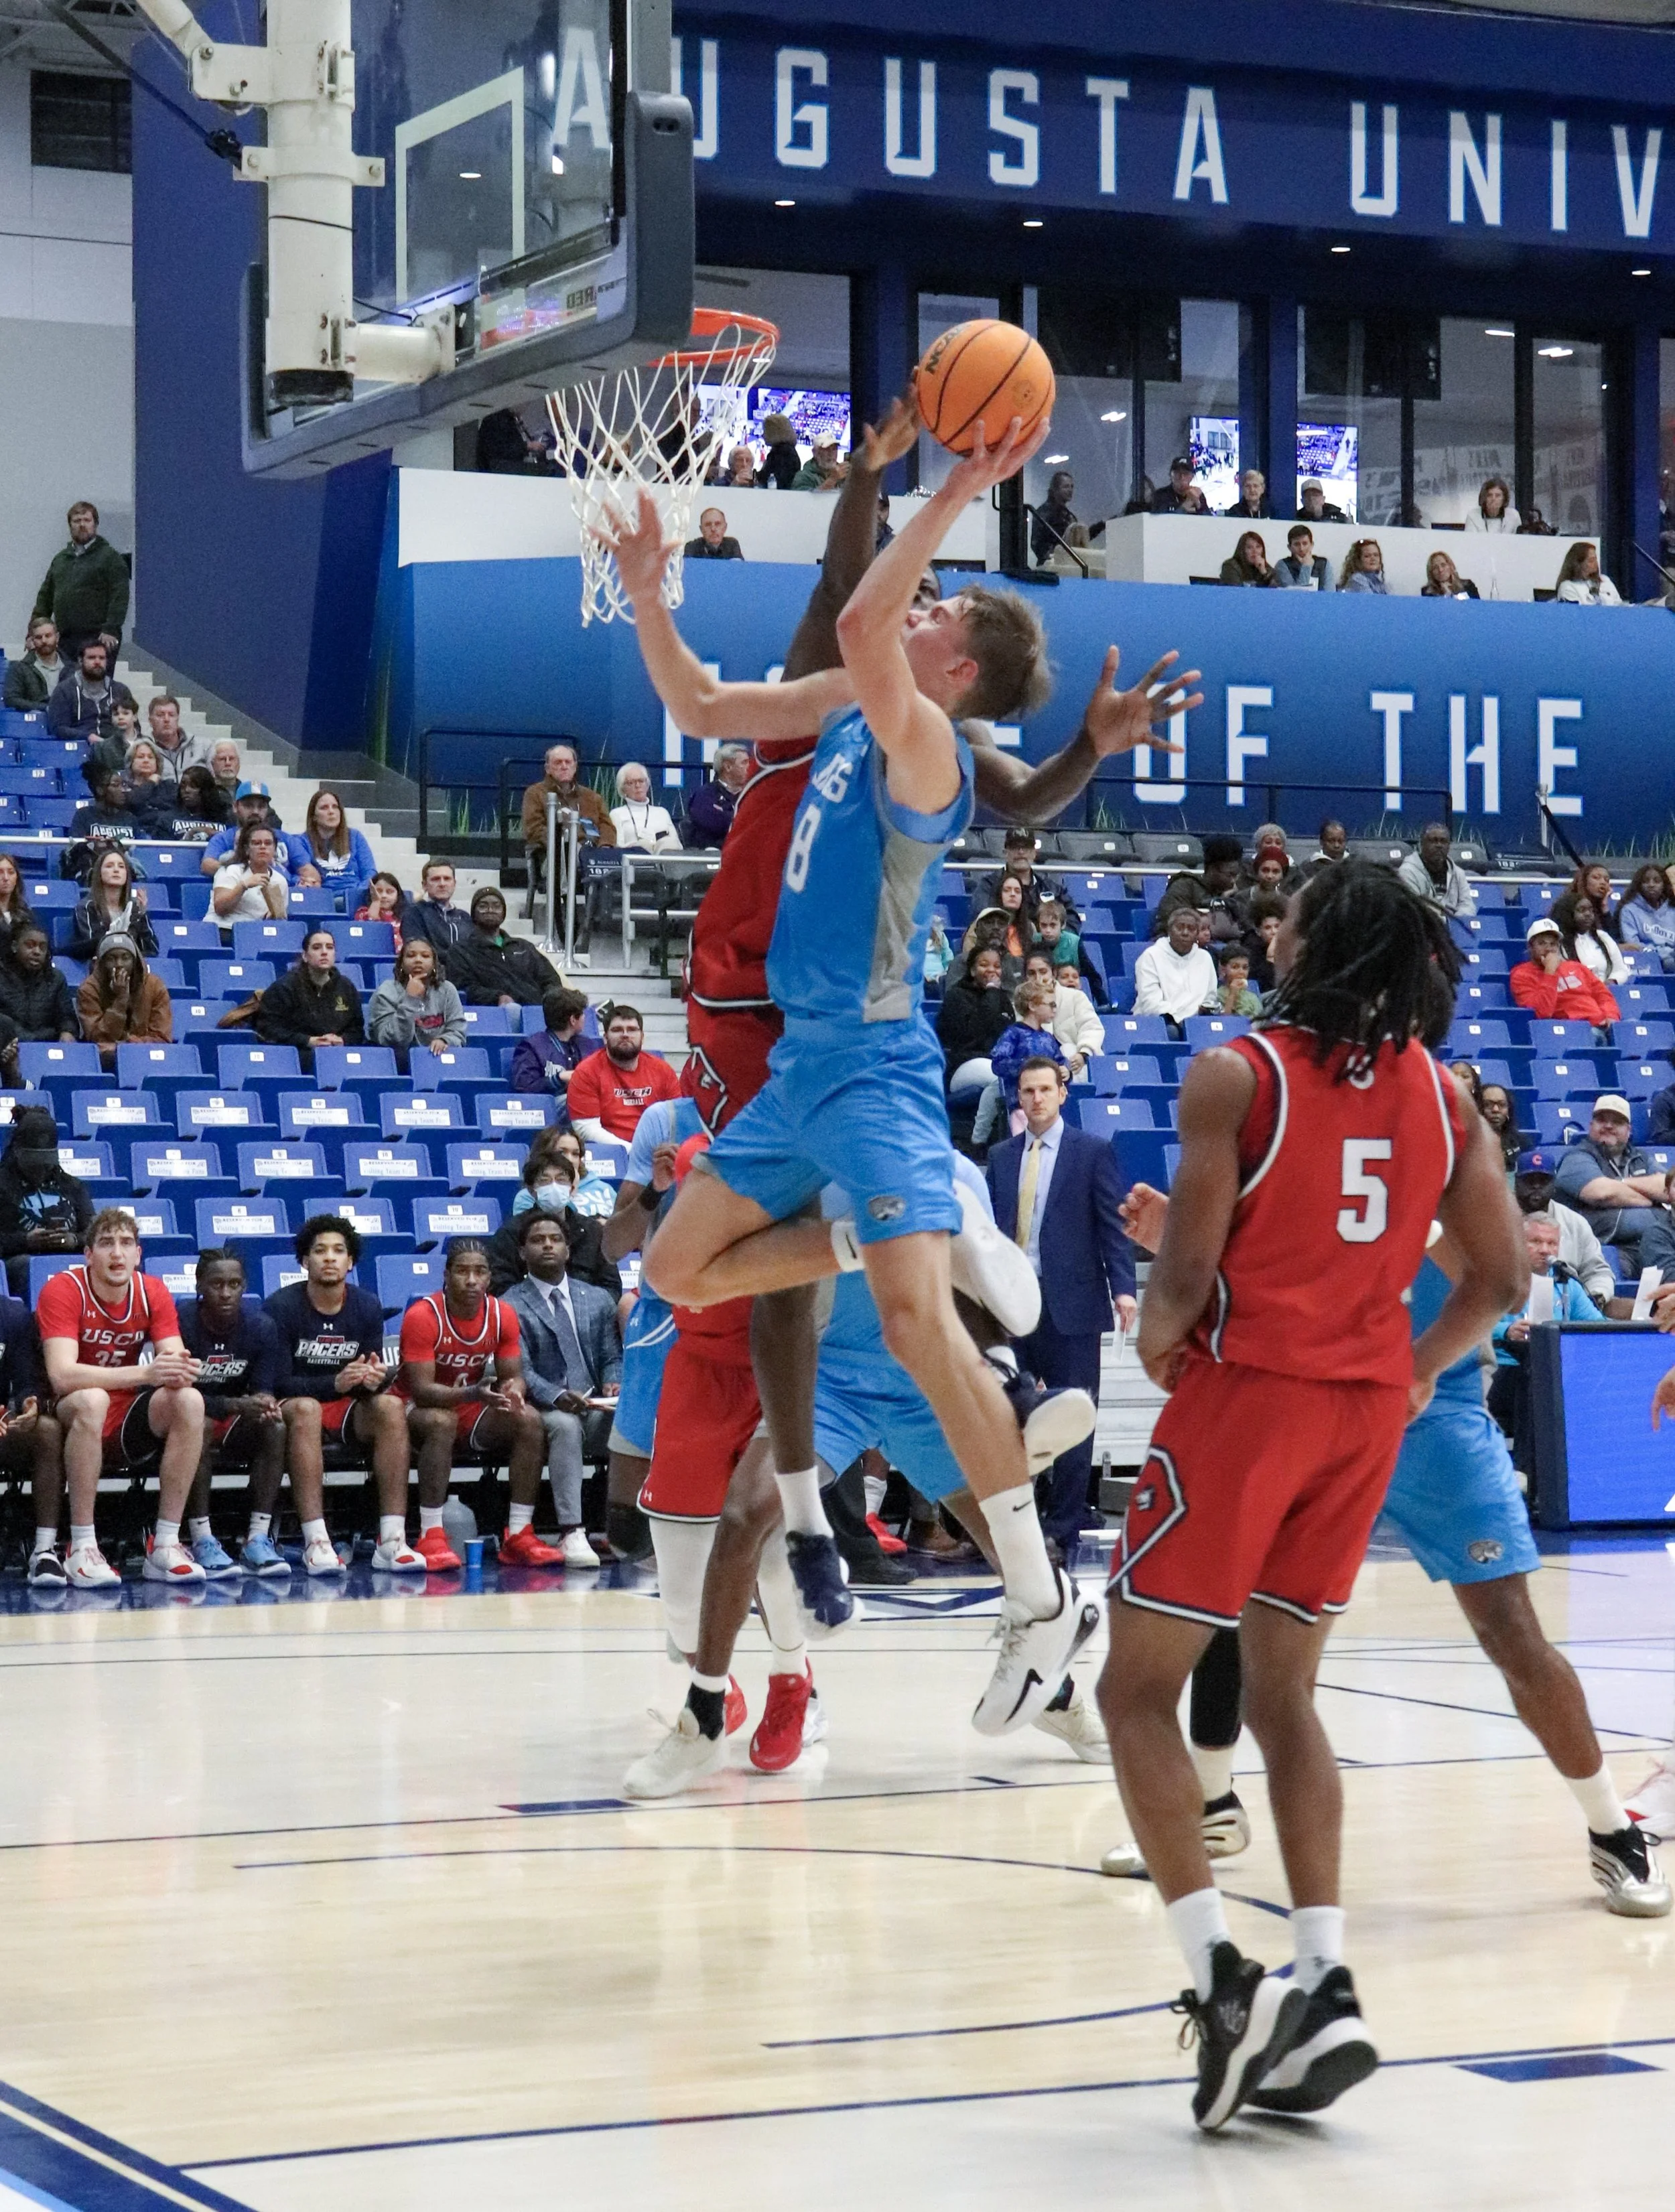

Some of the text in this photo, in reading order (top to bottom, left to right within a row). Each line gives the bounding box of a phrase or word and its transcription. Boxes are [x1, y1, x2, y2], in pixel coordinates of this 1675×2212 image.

[1371, 692, 1583, 816] THE
[786, 805, 821, 894] 8
[1337, 1138, 1392, 1243] 5
[82, 1328, 145, 1346] USCA
[297, 1341, 358, 1358] PACERS
